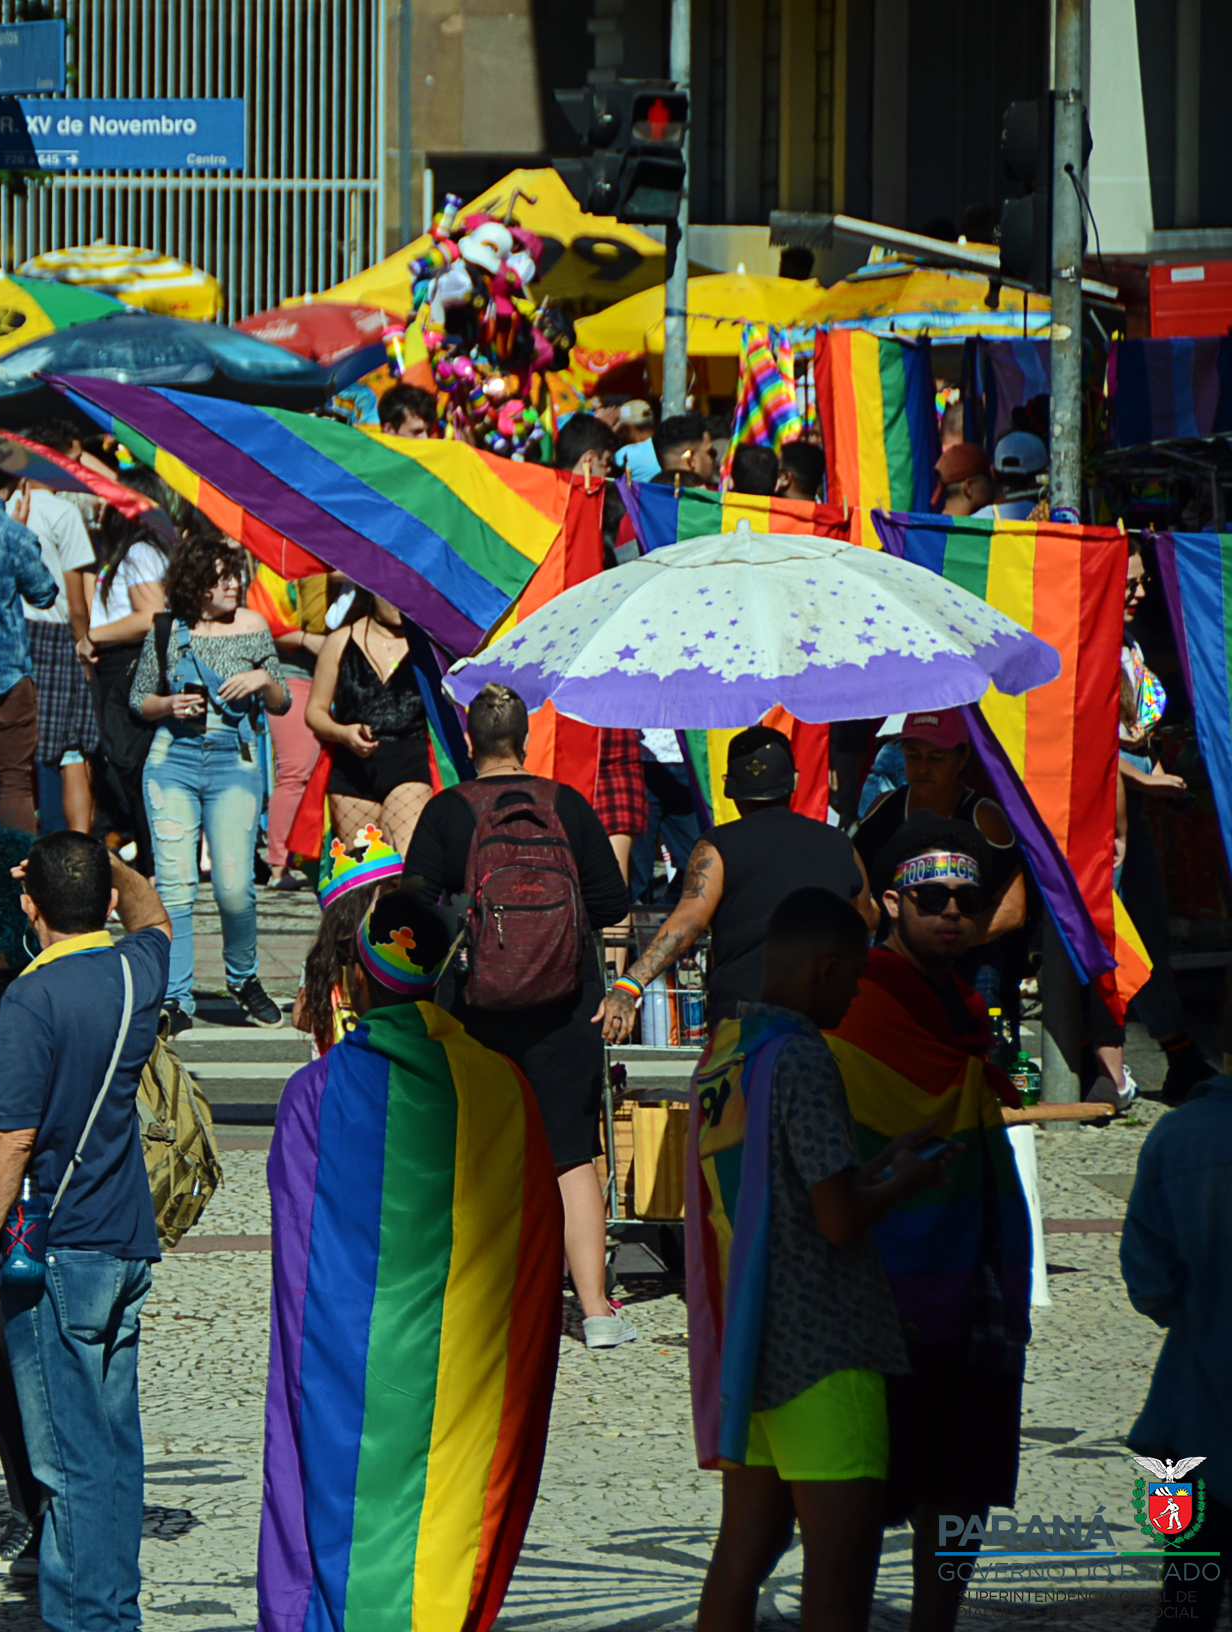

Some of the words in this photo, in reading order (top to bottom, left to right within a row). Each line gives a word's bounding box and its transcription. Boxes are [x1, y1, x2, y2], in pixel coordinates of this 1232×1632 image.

[0, 116, 19, 133] R.
[26, 115, 52, 134] XV
[57, 115, 84, 134] de
[90, 115, 198, 135] Novembro
[37, 154, 59, 165] 645
[186, 152, 227, 165] Centro
[902, 857, 941, 886] 100%
